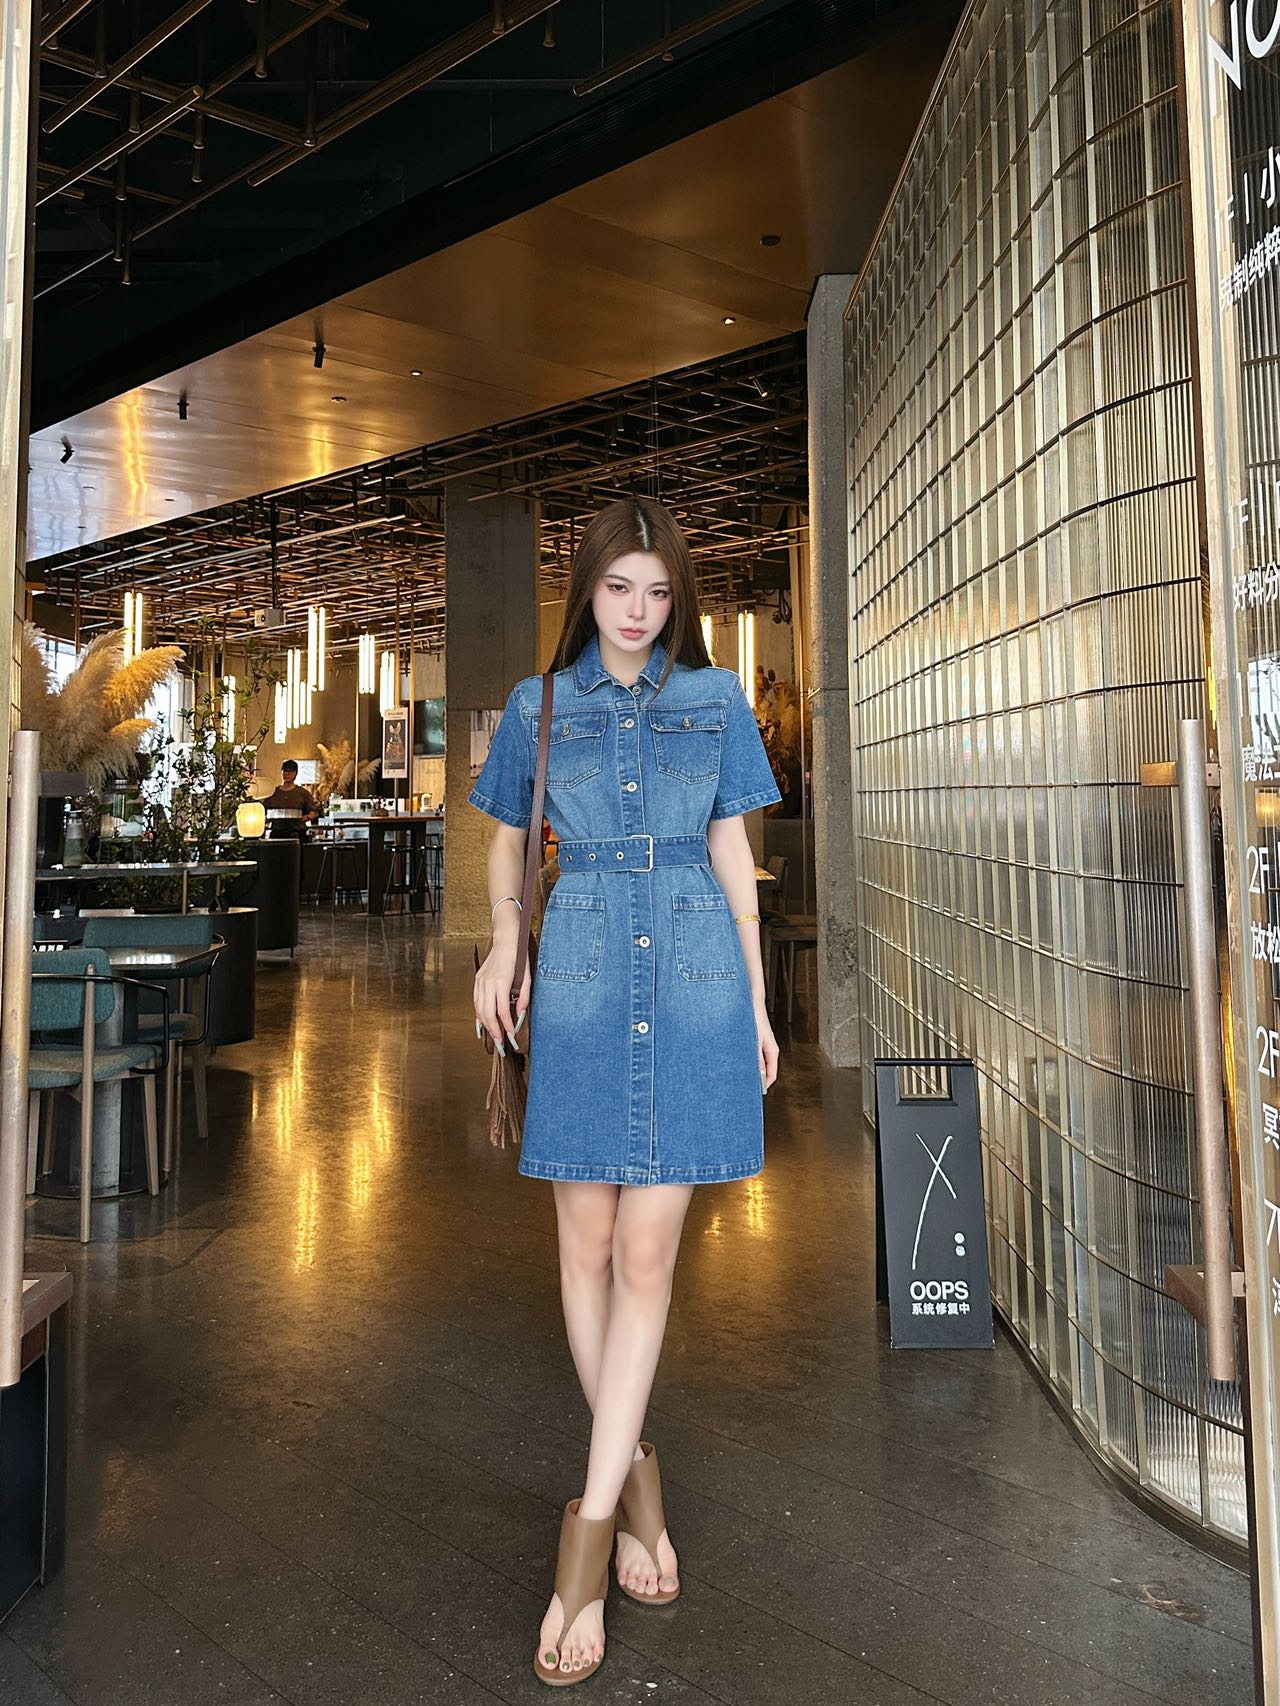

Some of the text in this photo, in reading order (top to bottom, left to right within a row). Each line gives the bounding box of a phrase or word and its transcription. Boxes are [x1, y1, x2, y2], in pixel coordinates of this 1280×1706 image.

[1247, 845, 1269, 894] 2F
[1256, 1025, 1280, 1078] 2F
[910, 1281, 969, 1300] OOPS
[911, 1302, 970, 1315] 系统修复中
